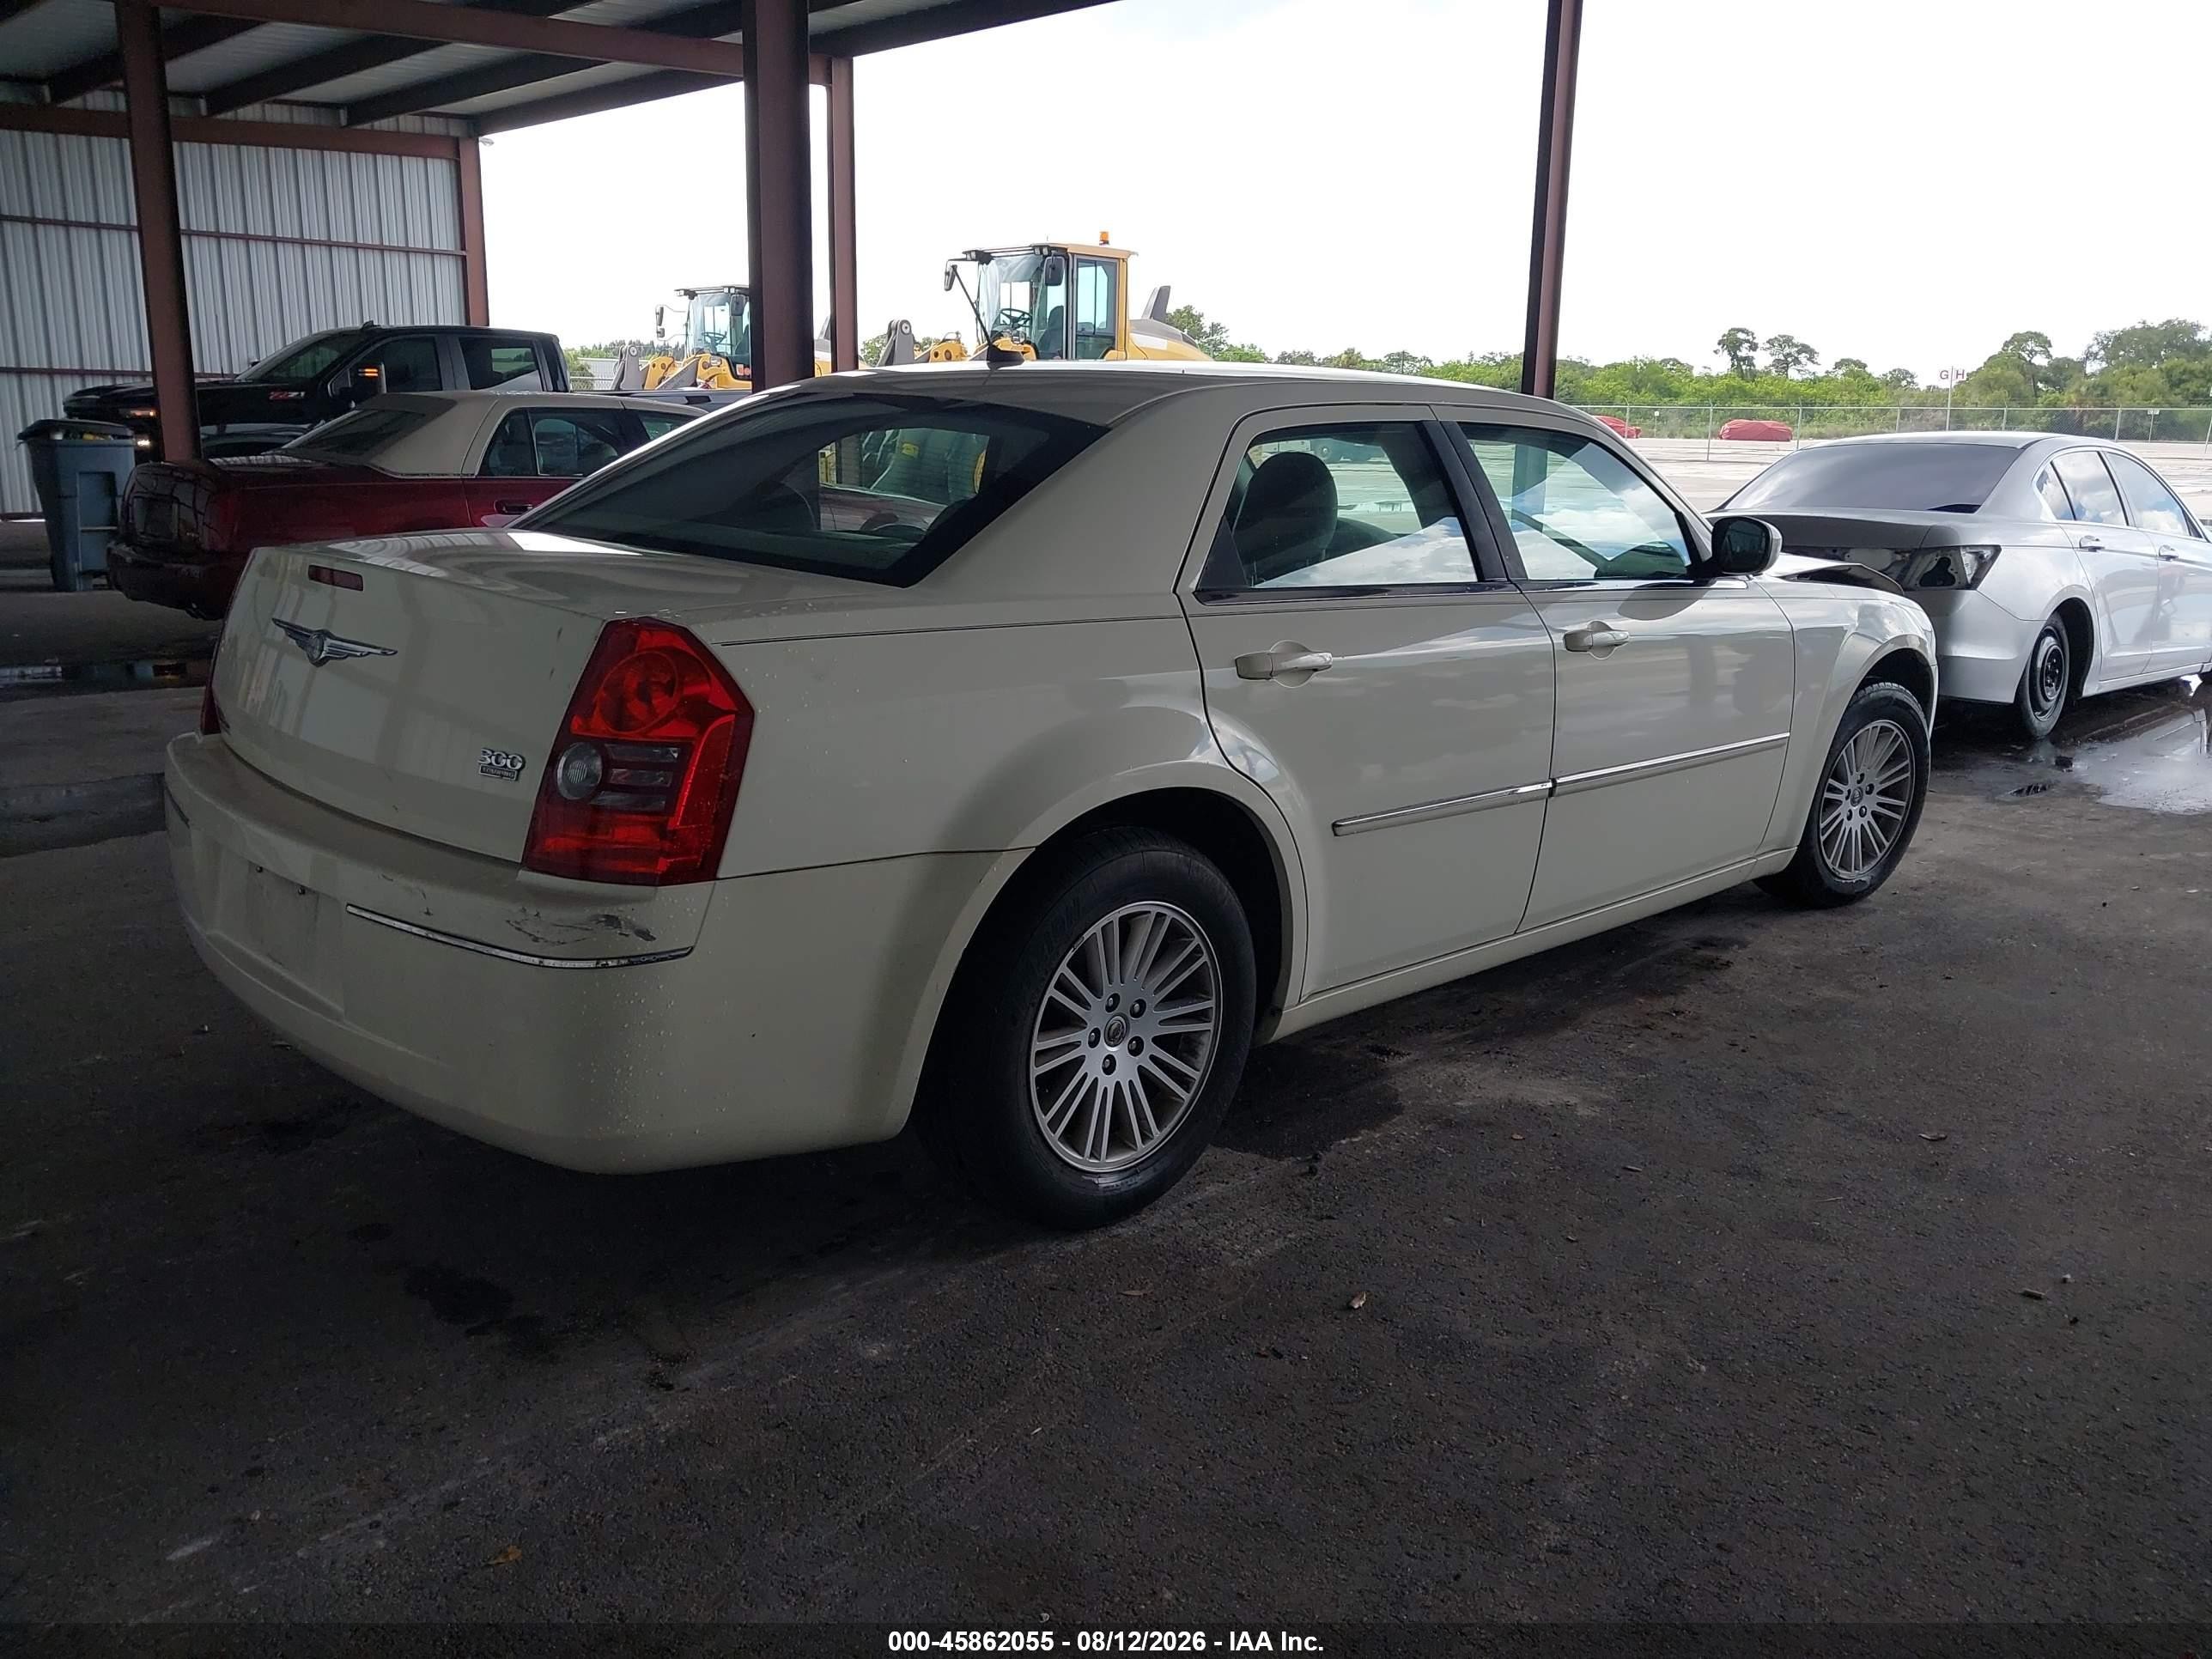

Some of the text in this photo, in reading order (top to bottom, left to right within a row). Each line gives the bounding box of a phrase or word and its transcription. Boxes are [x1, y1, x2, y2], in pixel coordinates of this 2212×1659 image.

[1939, 369, 1966, 380] G H
[477, 748, 523, 770] 300
